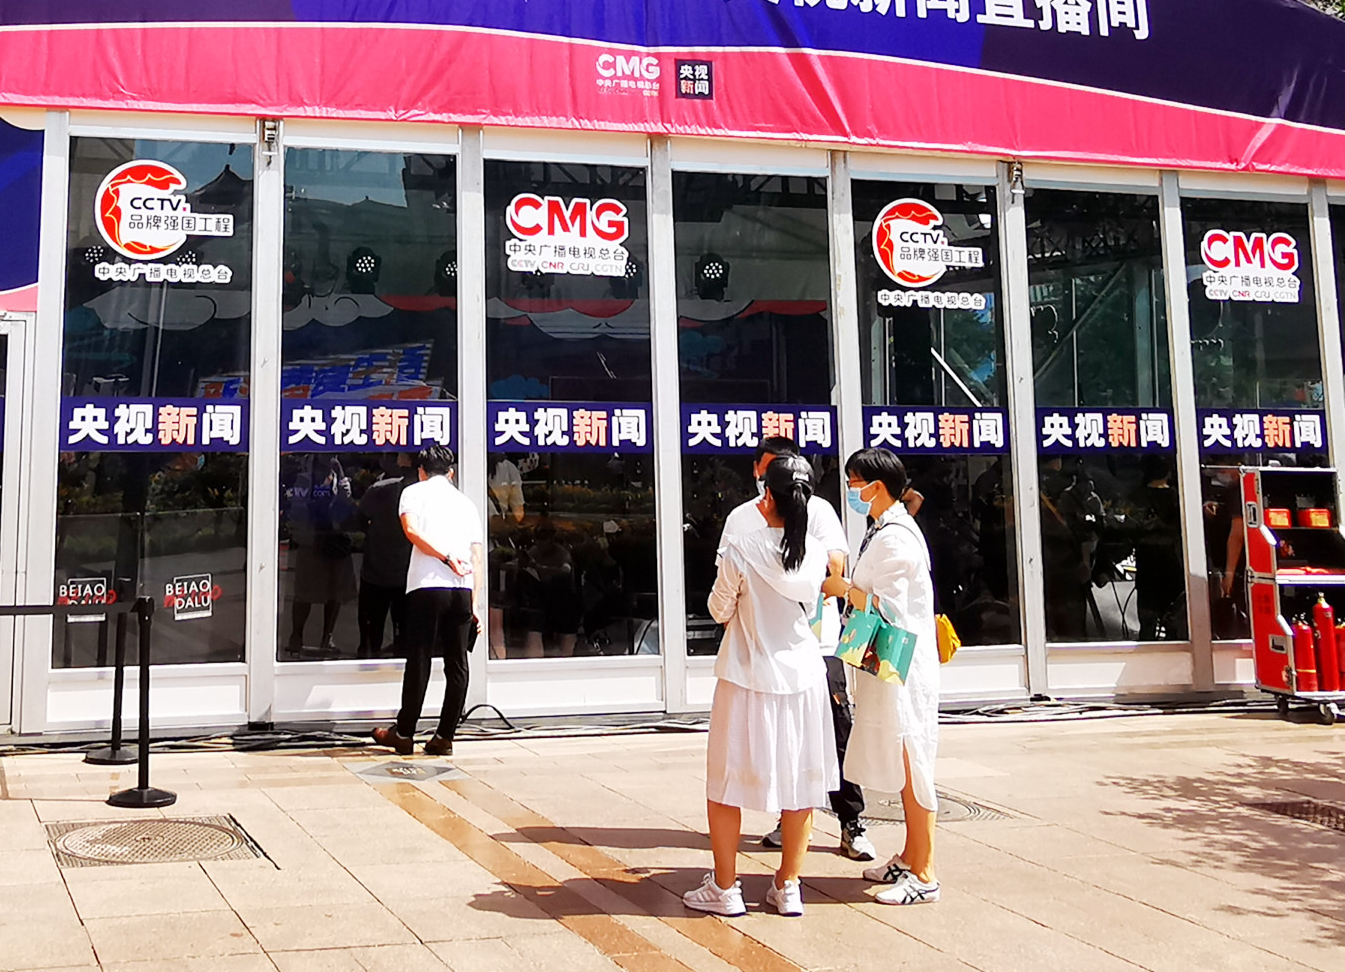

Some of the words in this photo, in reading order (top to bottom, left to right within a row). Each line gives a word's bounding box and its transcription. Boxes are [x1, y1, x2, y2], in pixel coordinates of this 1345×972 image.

[596, 54, 660, 80] CMG
[129, 214, 231, 233] 品牌强国工程
[510, 197, 625, 241] CMG
[509, 243, 625, 261] 中央广播电视总台
[899, 247, 980, 264] 品牌强国工程
[1204, 233, 1296, 271] CMG
[98, 266, 229, 281] 中央广播电视总台
[541, 261, 565, 270] CNR
[1205, 274, 1297, 289] 中央广播电视总台
[880, 293, 983, 307] 中央广播电视总台
[68, 404, 242, 446] 央视新闻
[288, 404, 452, 446] 央视新闻
[494, 407, 647, 447] 央视新闻
[687, 409, 833, 449] 央视新闻
[869, 411, 1005, 448] 央视新闻
[1042, 411, 1171, 449] 央视新闻
[1202, 413, 1323, 449] 央视新闻
[59, 583, 106, 597] BEIAO
[166, 579, 211, 596] BEIAO
[176, 596, 210, 610] DALU
